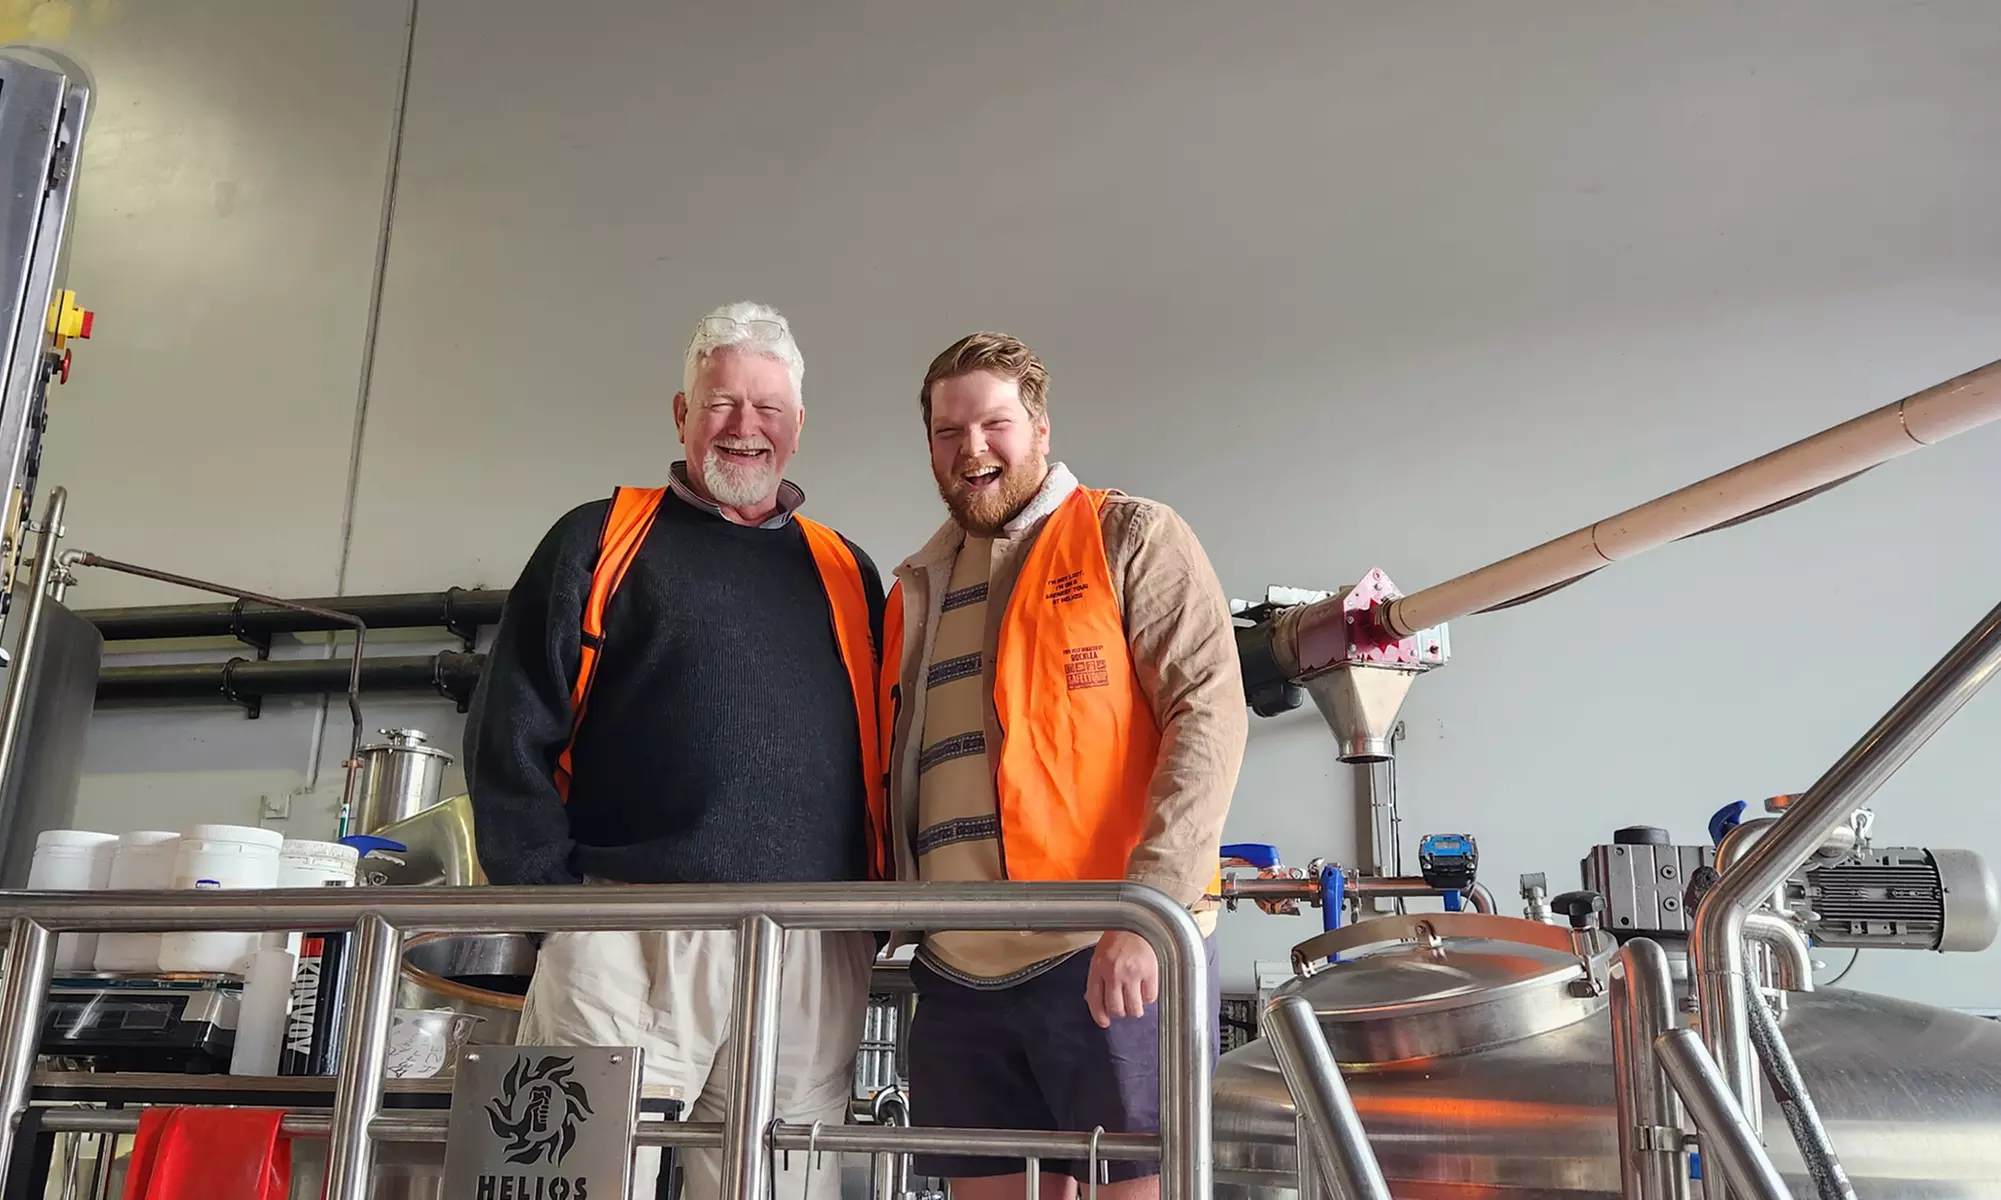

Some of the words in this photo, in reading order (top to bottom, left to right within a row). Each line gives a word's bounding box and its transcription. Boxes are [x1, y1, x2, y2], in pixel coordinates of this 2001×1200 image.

[1071, 651, 1098, 661] ROCKLEA
[286, 957, 321, 1056] KONVOY
[476, 1175, 588, 1200] HELIOS
